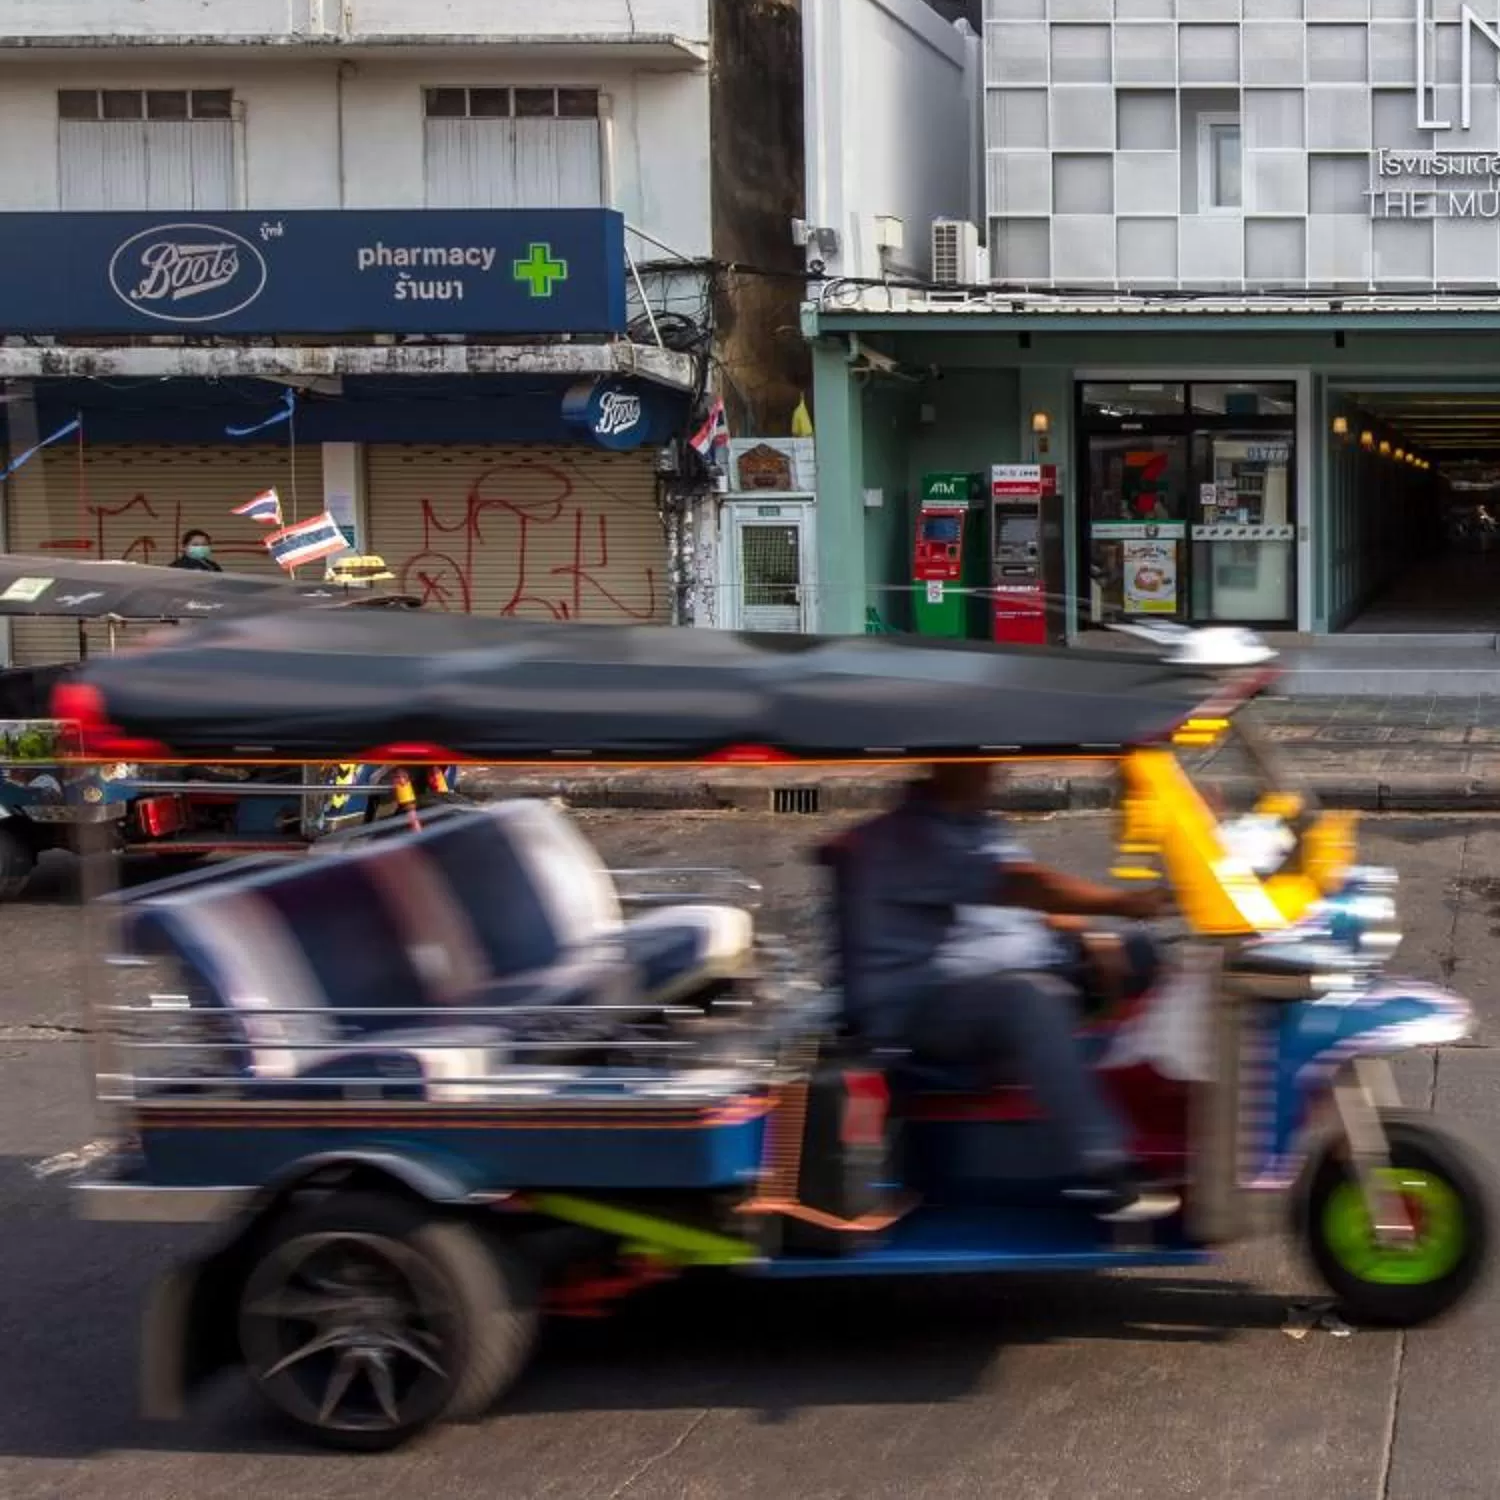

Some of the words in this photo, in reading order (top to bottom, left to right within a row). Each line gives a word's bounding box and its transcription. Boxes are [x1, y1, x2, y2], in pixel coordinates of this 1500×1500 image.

[1363, 189, 1430, 218] THE
[357, 241, 497, 271] pharmacy
[129, 242, 240, 301] Boots
[394, 271, 463, 300] ร้านยา
[929, 481, 955, 494] ATM
